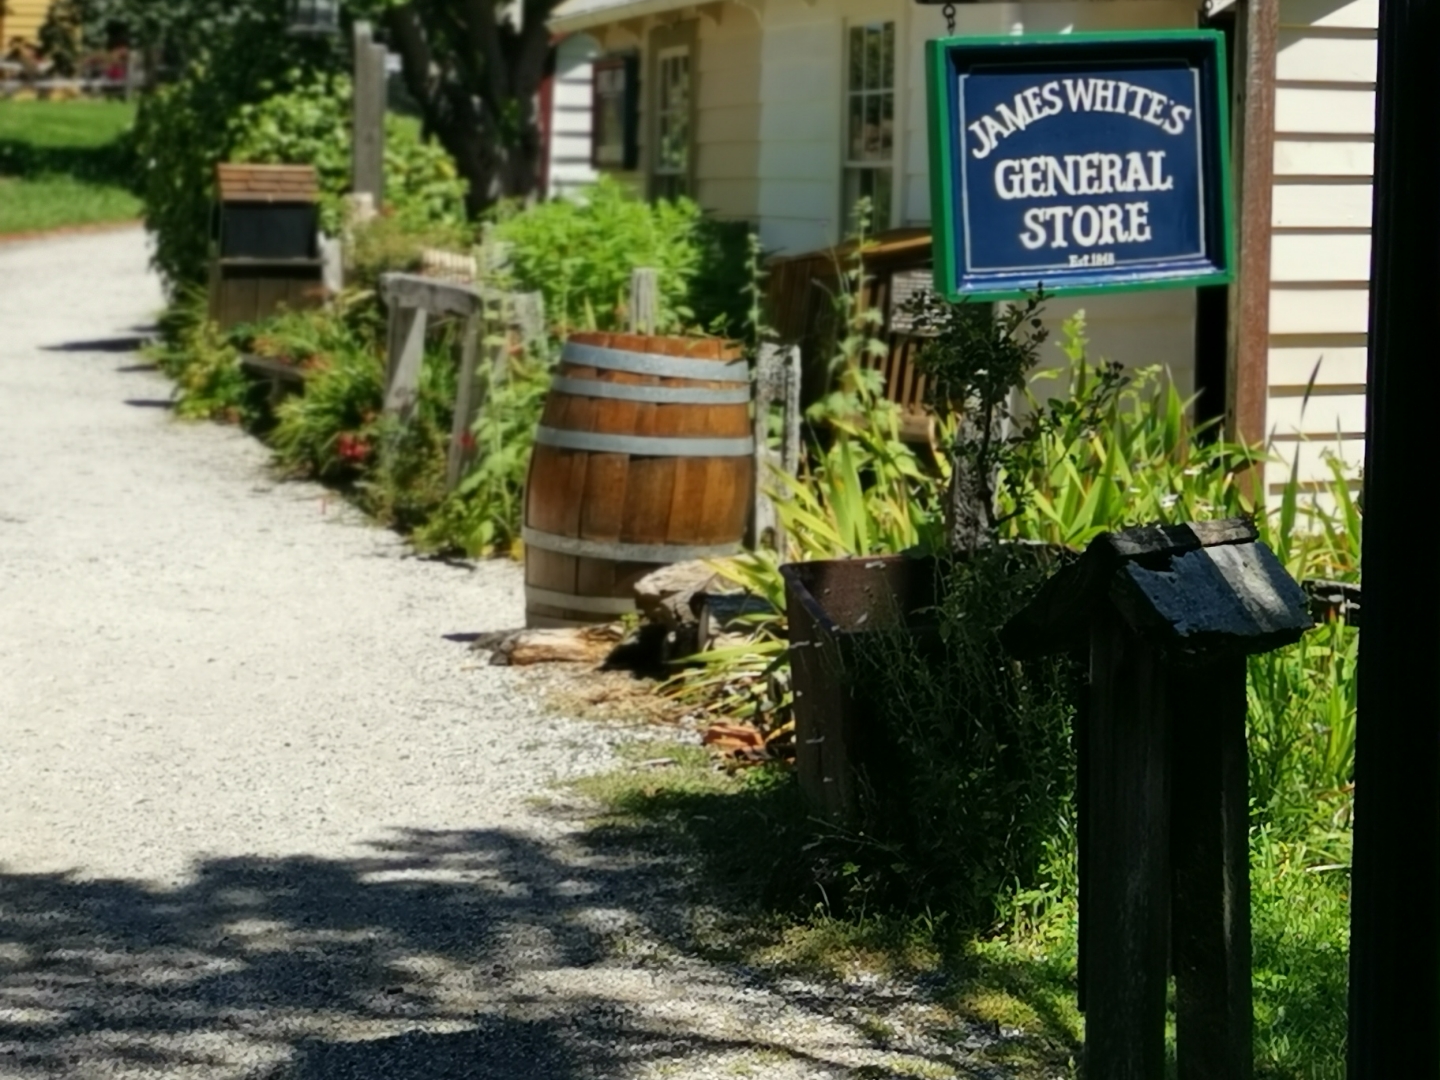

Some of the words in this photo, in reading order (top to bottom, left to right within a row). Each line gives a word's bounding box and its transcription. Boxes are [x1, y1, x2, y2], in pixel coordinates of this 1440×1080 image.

[968, 81, 1064, 159] JAMES
[994, 151, 1173, 200] GENERAL
[1019, 202, 1151, 250] STORE
